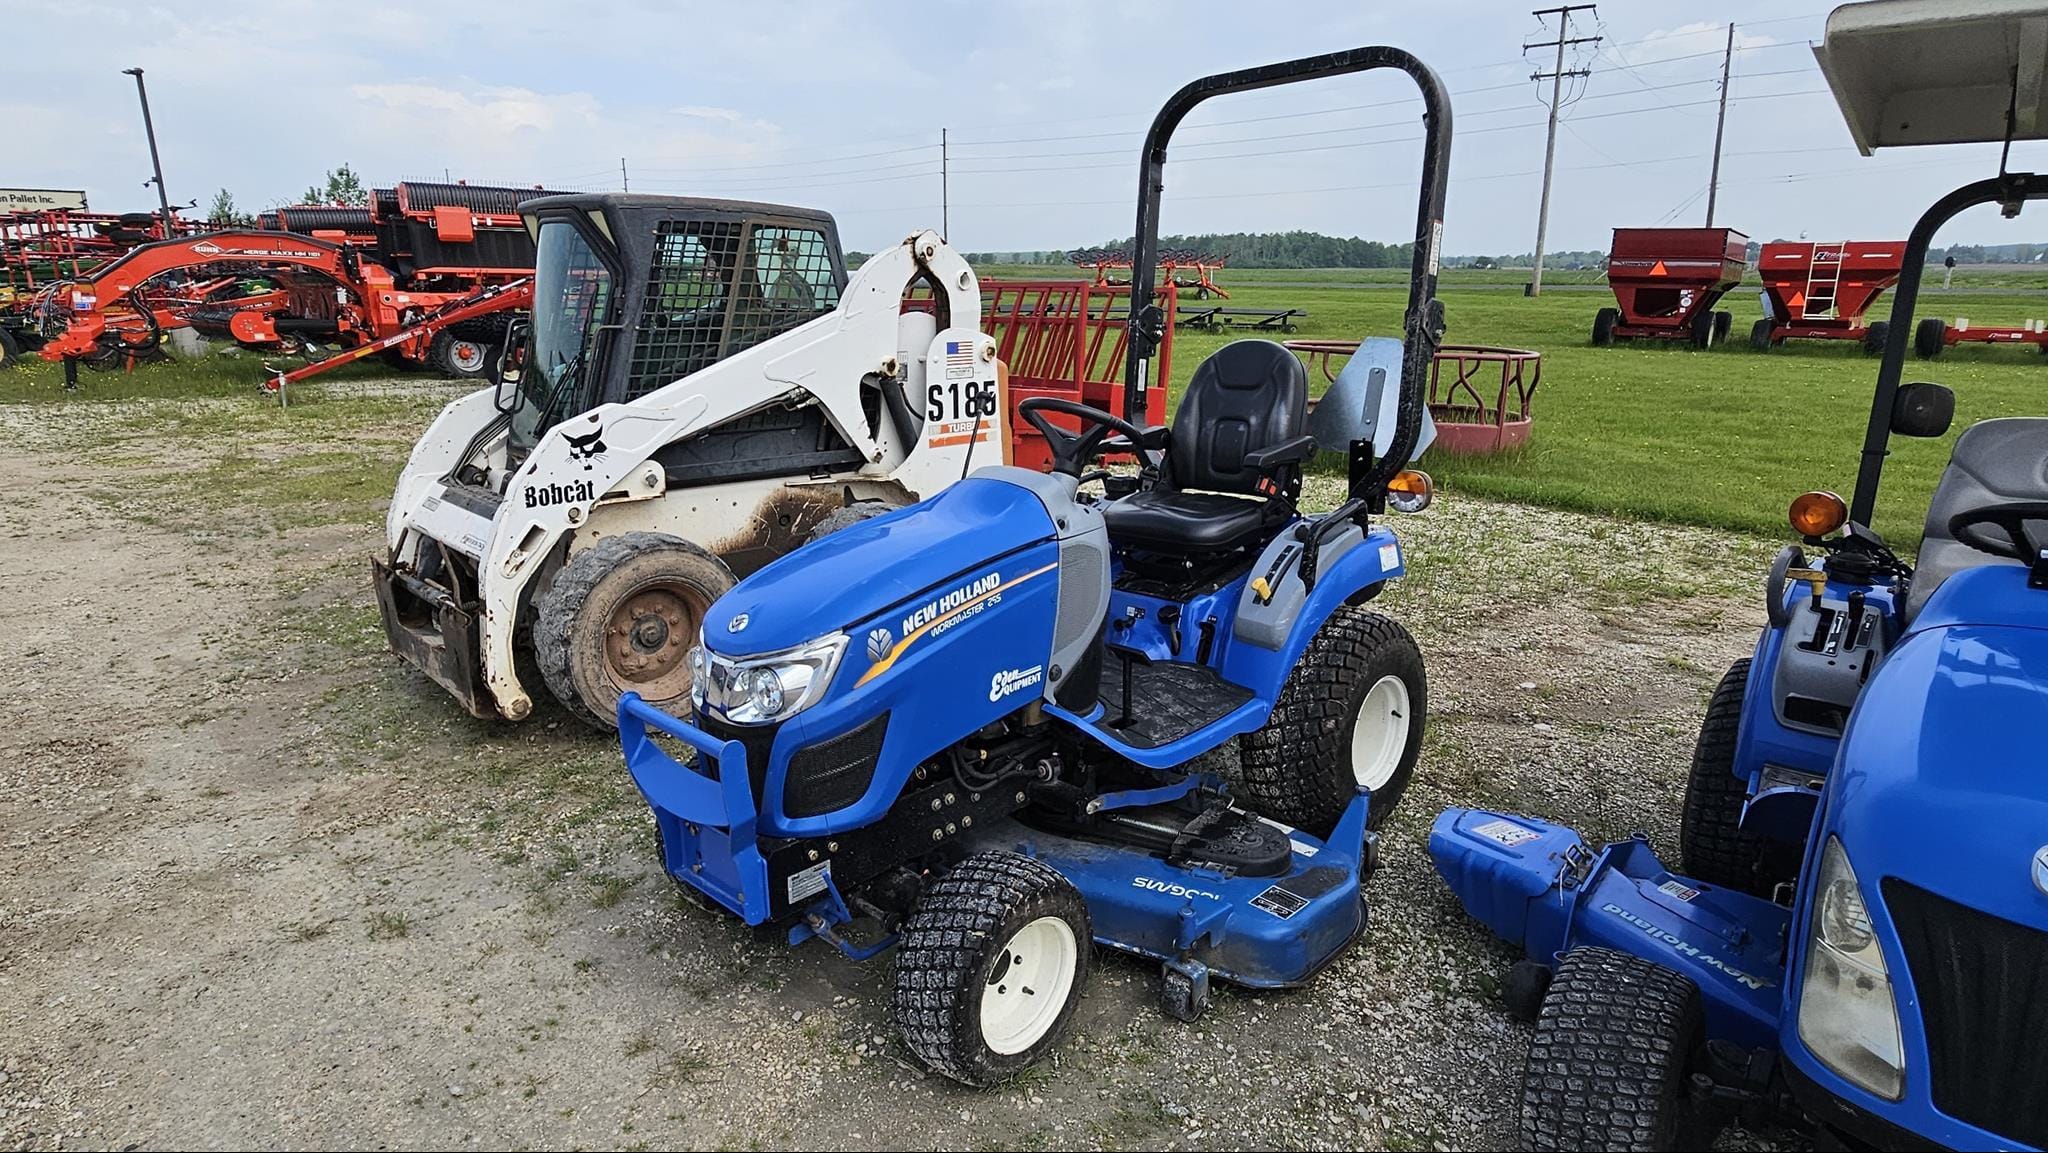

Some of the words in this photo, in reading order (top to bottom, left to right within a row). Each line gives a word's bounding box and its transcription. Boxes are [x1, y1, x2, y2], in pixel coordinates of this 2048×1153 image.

[9, 194, 37, 204] Pallet
[928, 380, 996, 422] S185
[948, 422, 977, 433] TURB
[524, 480, 595, 509] Bobcat
[902, 605, 937, 636] NEW
[939, 572, 1001, 614] HOLLAND
[930, 602, 985, 638] WORKMASTER
[1602, 903, 1700, 957] Holland
[1699, 954, 1764, 990] New
